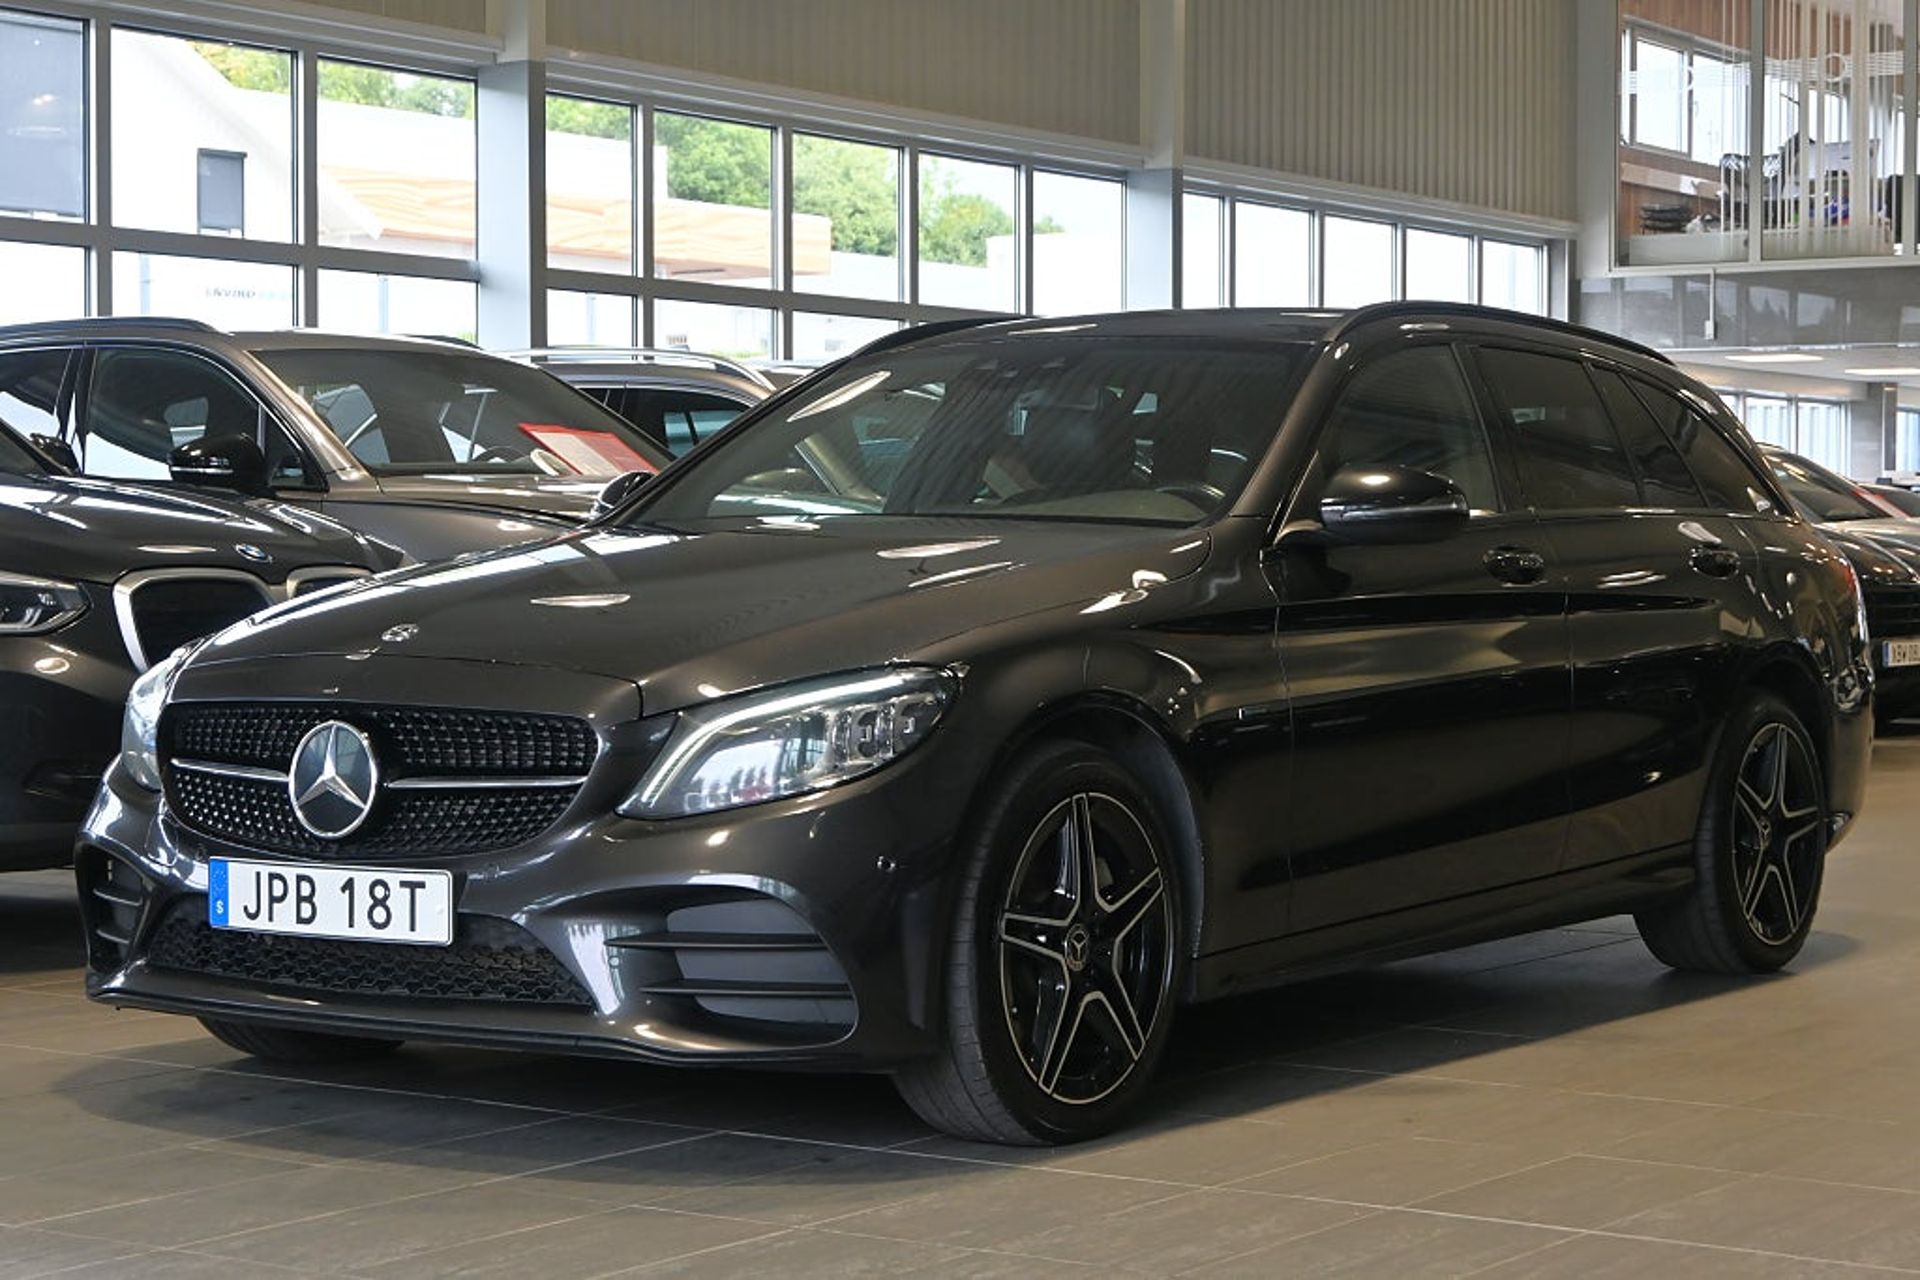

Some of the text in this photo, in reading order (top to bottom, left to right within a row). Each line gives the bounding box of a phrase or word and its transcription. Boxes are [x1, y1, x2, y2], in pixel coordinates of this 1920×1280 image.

[214, 900, 224, 914] S
[243, 871, 426, 932] JPB 18T
